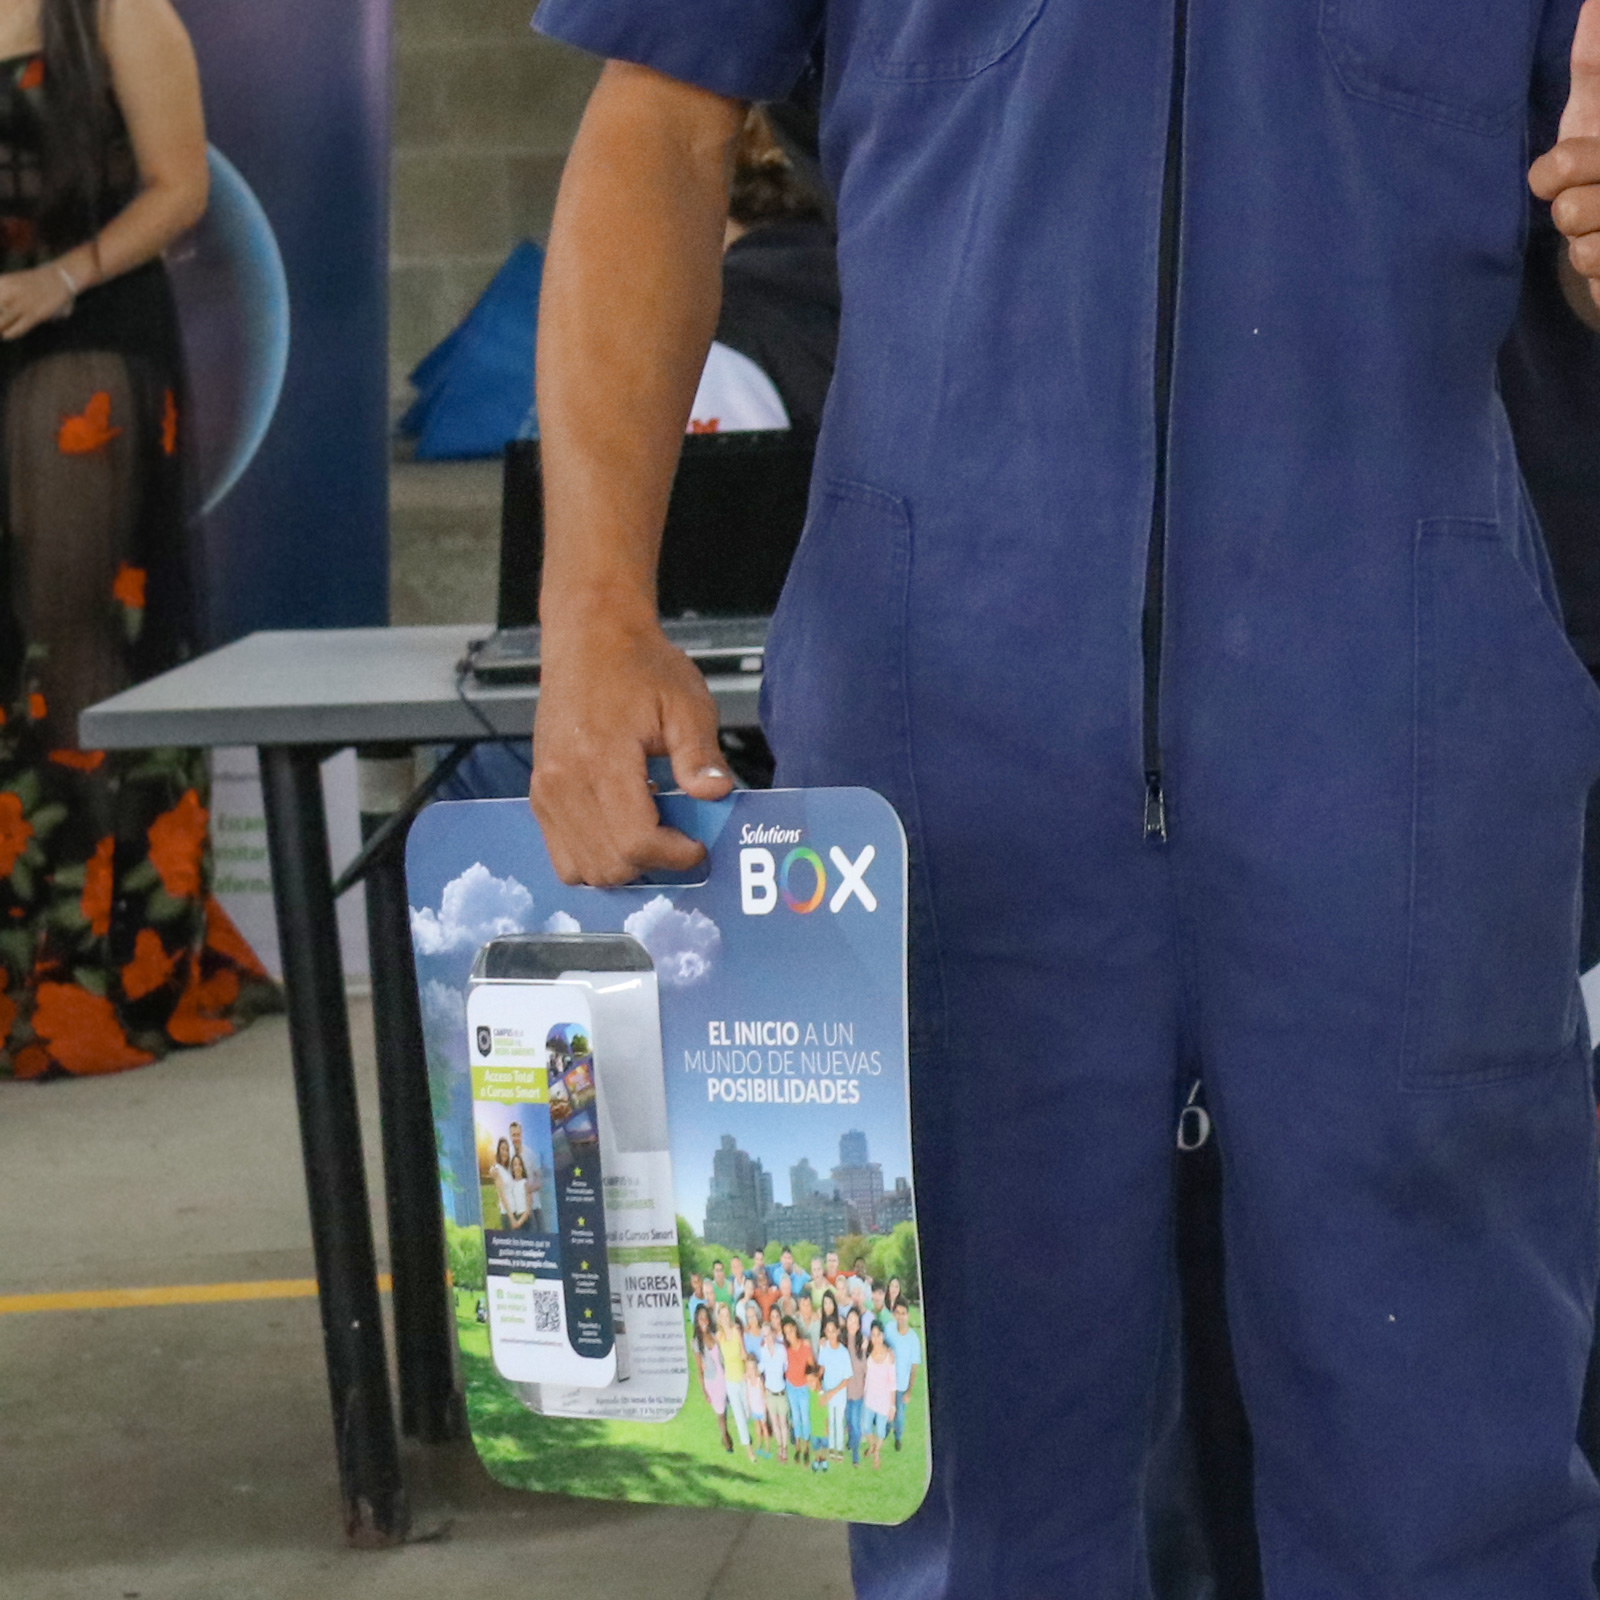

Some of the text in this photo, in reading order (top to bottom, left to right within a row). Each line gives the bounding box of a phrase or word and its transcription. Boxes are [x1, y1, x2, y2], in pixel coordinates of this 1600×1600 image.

[739, 823, 802, 846] Solutions
[739, 844, 877, 916] BOX
[708, 1021, 853, 1046] EL INICIO A UN
[684, 1050, 882, 1076] MUNDO DE NUEVAS
[484, 1069, 534, 1083] Acceso Total
[487, 1086, 514, 1097] Cursos
[516, 1086, 541, 1098] Smart
[707, 1078, 861, 1104] POSIBILIDADES
[625, 1276, 678, 1290] INGRESA
[627, 1293, 680, 1308] Y ACTIVA
